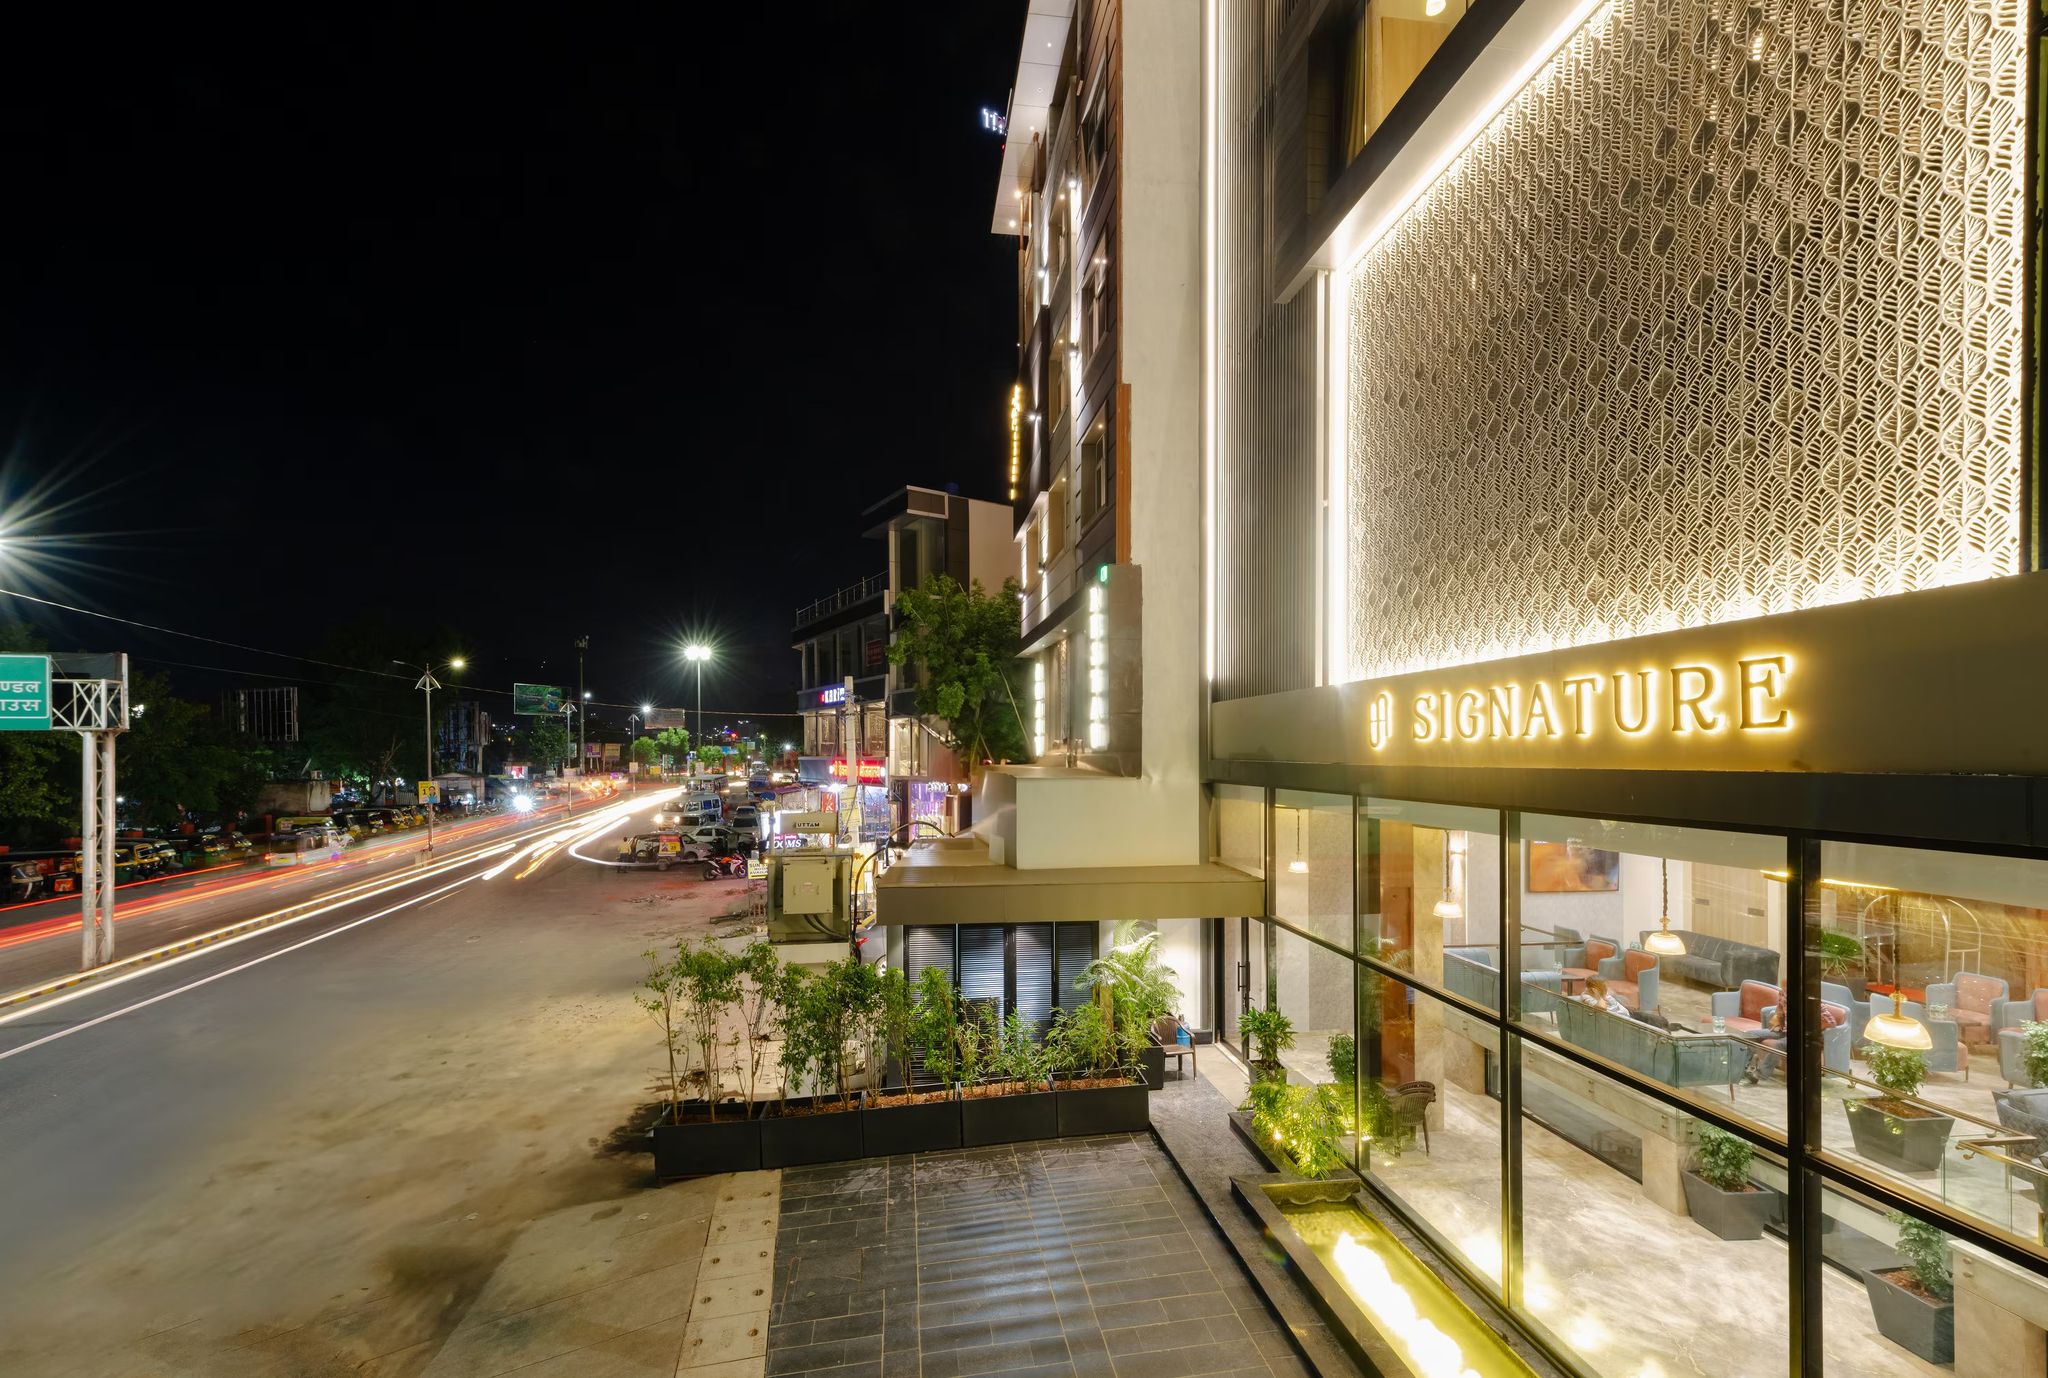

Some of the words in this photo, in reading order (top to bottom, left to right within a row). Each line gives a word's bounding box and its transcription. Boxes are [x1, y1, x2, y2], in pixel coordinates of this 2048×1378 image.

[0, 681, 41, 693] ण्डल
[1412, 657, 1788, 740] SIGNATURE
[0, 699, 42, 711] ाउस
